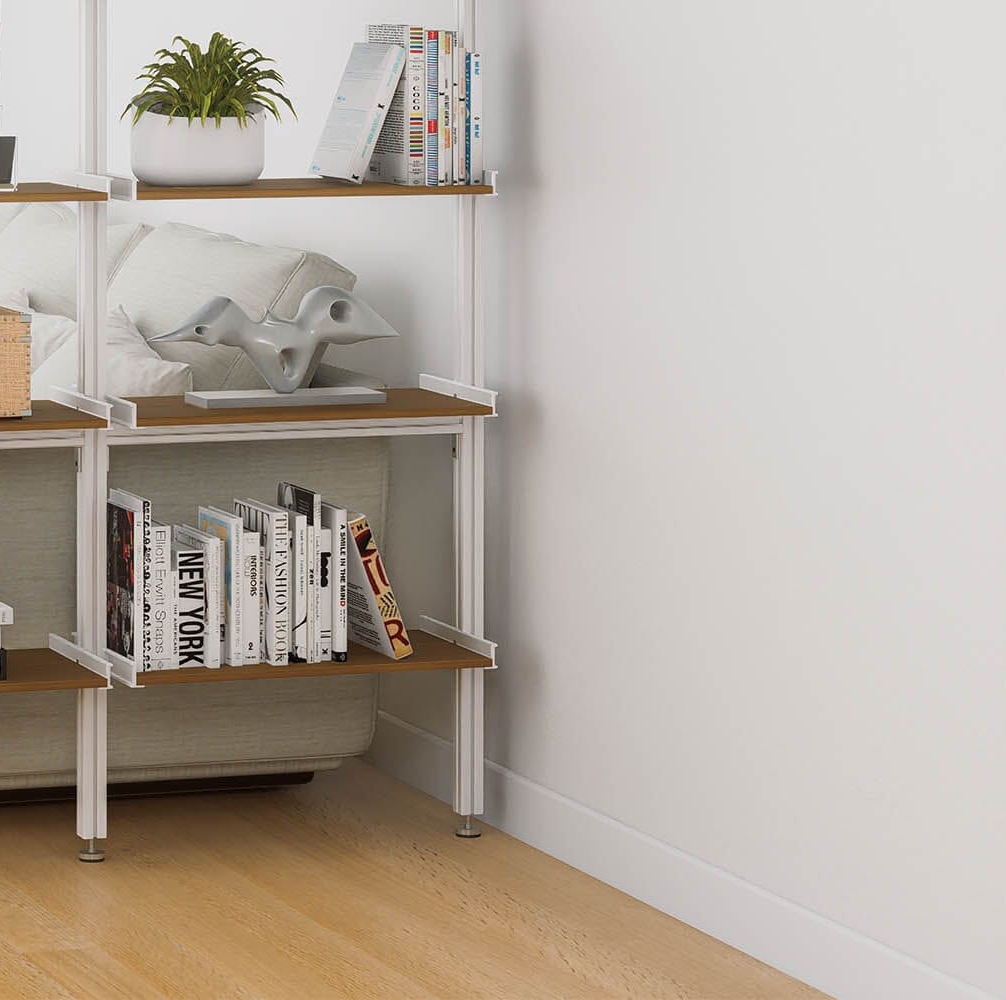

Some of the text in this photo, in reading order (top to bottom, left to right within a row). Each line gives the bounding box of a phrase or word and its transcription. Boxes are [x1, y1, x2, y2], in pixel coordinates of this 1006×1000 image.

[154, 530, 166, 654] Elliott Erwitt Snaps
[178, 553, 204, 666] NEW YORK
[275, 514, 287, 663] THE FASHION BOOK
[340, 558, 346, 566] IN
[248, 642, 254, 650] 2
